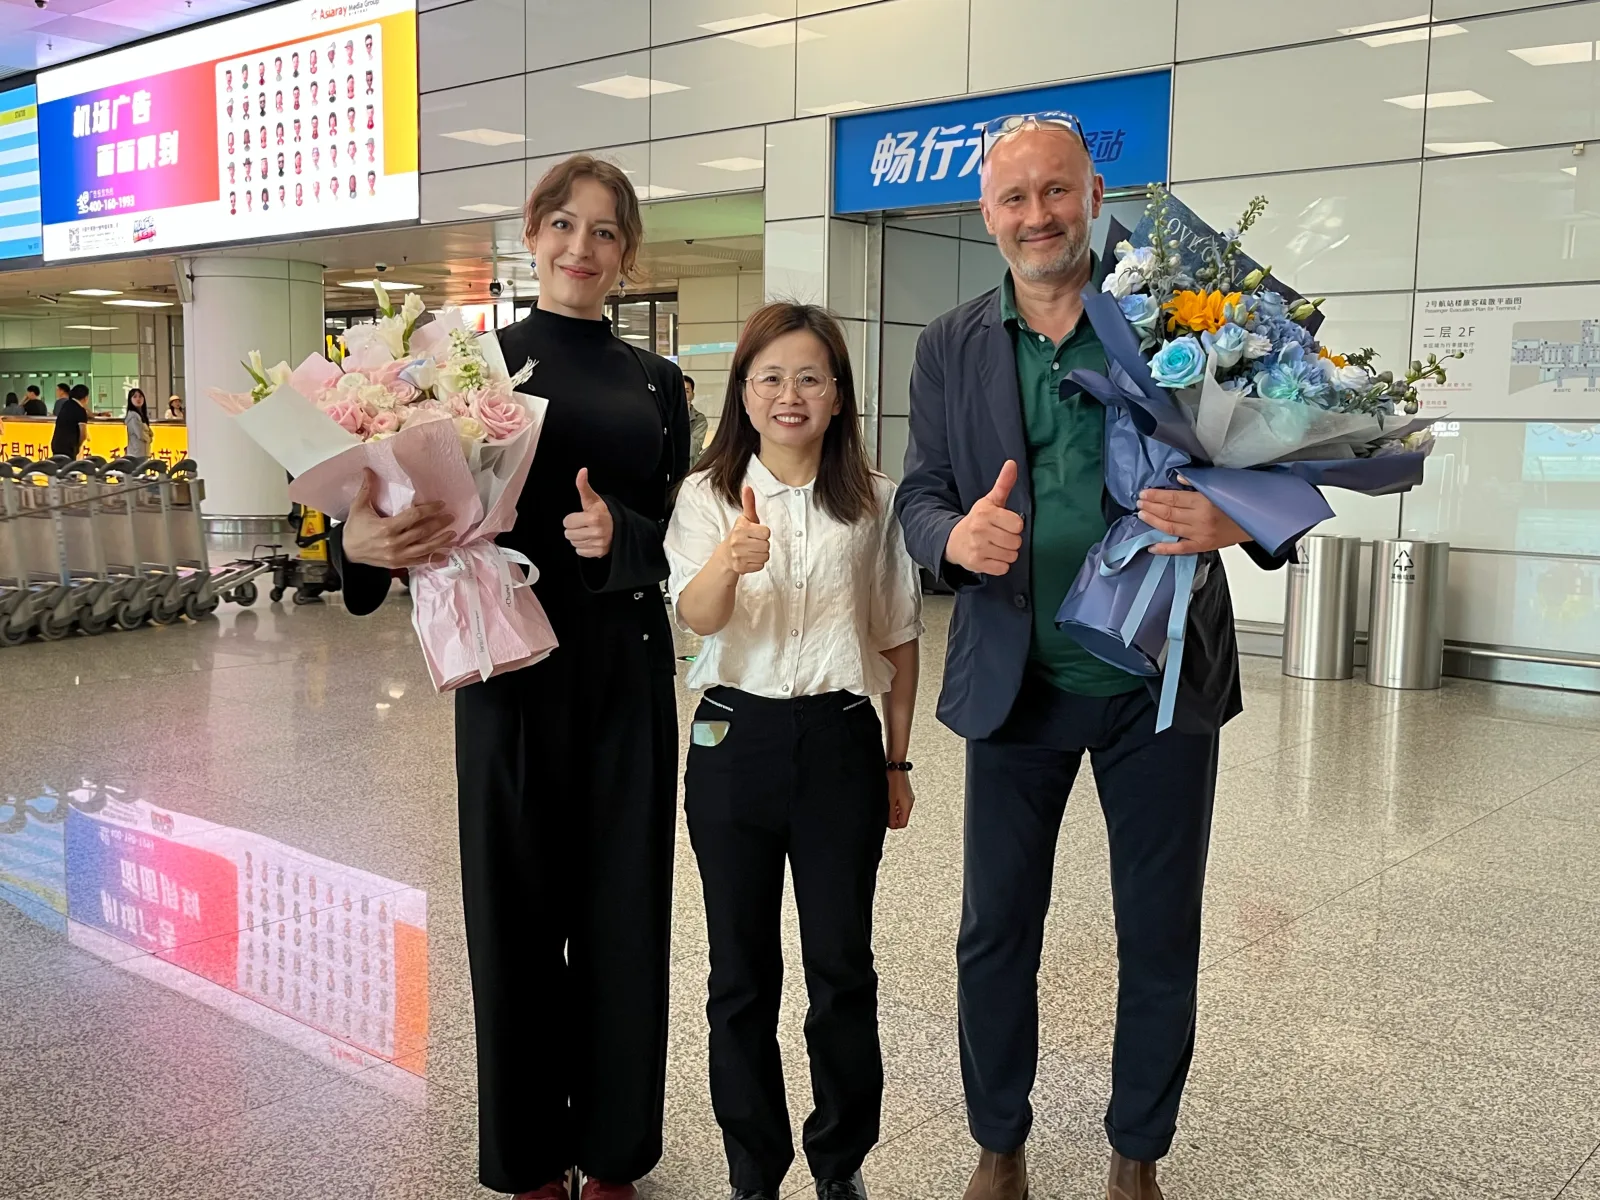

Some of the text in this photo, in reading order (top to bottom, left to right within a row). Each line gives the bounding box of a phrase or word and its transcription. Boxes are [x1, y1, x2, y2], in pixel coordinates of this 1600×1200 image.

[320, 7, 347, 20] Asiaray
[348, 2, 363, 12] Media
[364, 0, 379, 8] Group
[72, 89, 151, 138] 机场广告
[1423, 326, 1476, 338] 二层 2F
